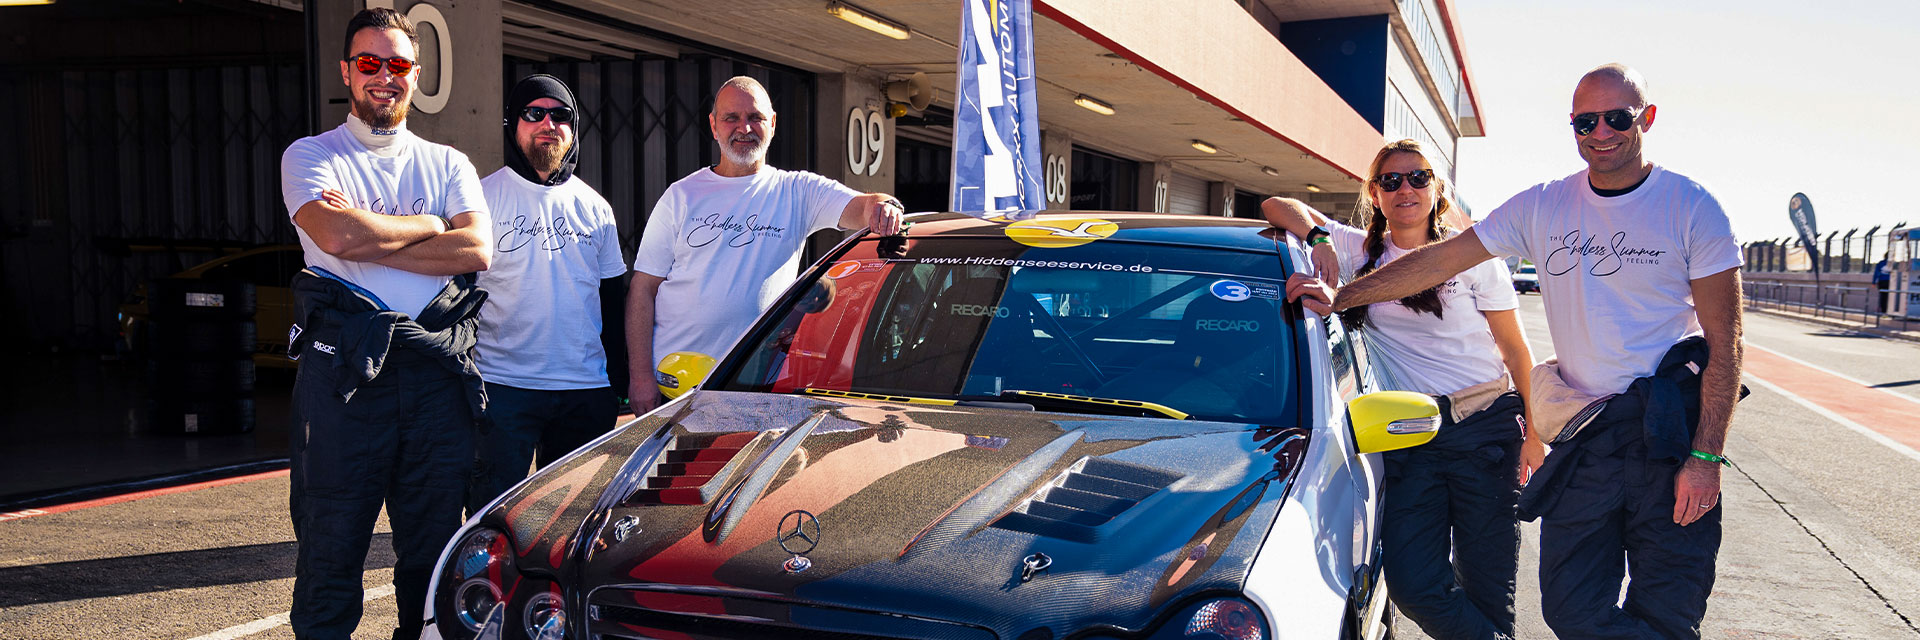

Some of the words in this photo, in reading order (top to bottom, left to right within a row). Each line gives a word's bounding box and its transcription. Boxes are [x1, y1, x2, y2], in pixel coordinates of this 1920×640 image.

[999, 0, 1019, 113] AUTOM
[846, 107, 885, 177] 09
[1046, 153, 1067, 204] 08
[1154, 180, 1168, 214] 07
[568, 236, 592, 246] FLING
[686, 213, 744, 248] Endless
[728, 214, 785, 248] Summer
[920, 256, 1153, 273] www.Hiddenseeservice.de
[1545, 229, 1606, 276] Endless
[1589, 231, 1666, 276] Summer
[1626, 257, 1660, 265] FEELING
[1221, 285, 1248, 300] 3
[950, 303, 1010, 319] RECARO
[1195, 319, 1260, 332] RECARO
